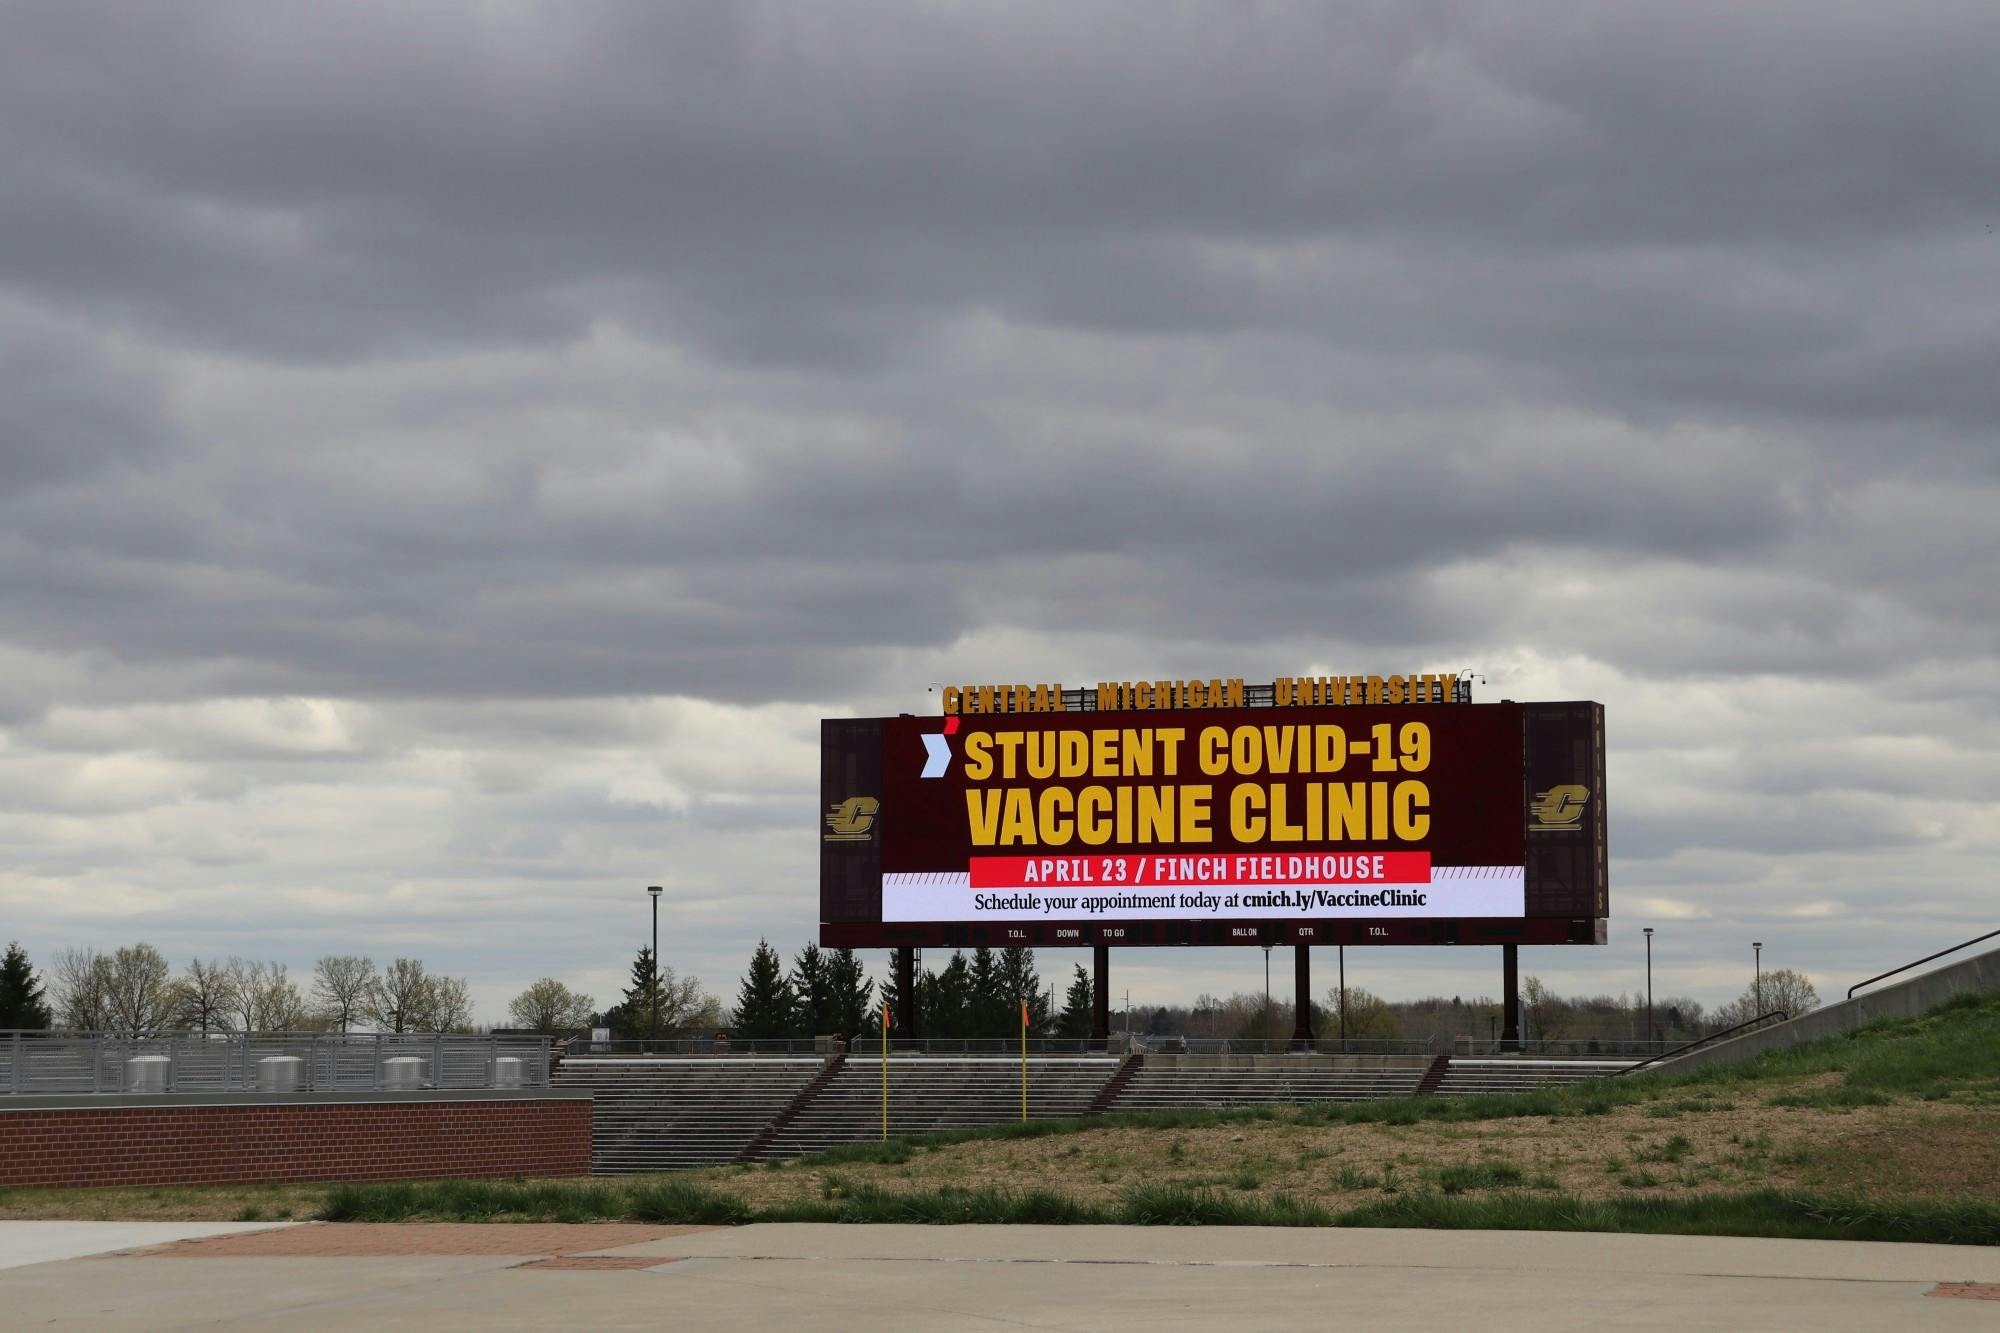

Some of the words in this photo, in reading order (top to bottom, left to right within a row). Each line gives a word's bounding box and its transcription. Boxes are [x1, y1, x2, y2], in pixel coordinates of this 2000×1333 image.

[943, 683, 1067, 714] CENTRAL
[1098, 679, 1244, 711] MICHIGAN
[1275, 674, 1457, 706] UNIVERSITY
[965, 728, 1185, 780] STUDENT
[1199, 722, 1431, 776] COVID-19
[965, 785, 1213, 845] VACCINE
[1230, 780, 1430, 843] CLINIC
[1024, 860, 1094, 882] APRIL
[1102, 859, 1127, 881] 23
[1155, 857, 1227, 881] FINCH
[1236, 855, 1385, 880] FIELDHOUSE
[974, 893, 1041, 910] Schedule
[1044, 896, 1078, 913] your
[1081, 893, 1176, 912] appointment
[1179, 891, 1221, 912] today
[1224, 893, 1240, 908] at
[1242, 889, 1427, 912] cmich.ly/VaccineClinic
[1008, 930, 1027, 938] T.O.L.
[1056, 929, 1079, 938] DOWN
[1103, 929, 1112, 937] TO
[1114, 929, 1125, 937] GO
[1232, 928, 1247, 936] BALL
[1248, 928, 1257, 936] ON
[1299, 927, 1314, 936] QTR
[1369, 927, 1389, 936] T.O.L.
